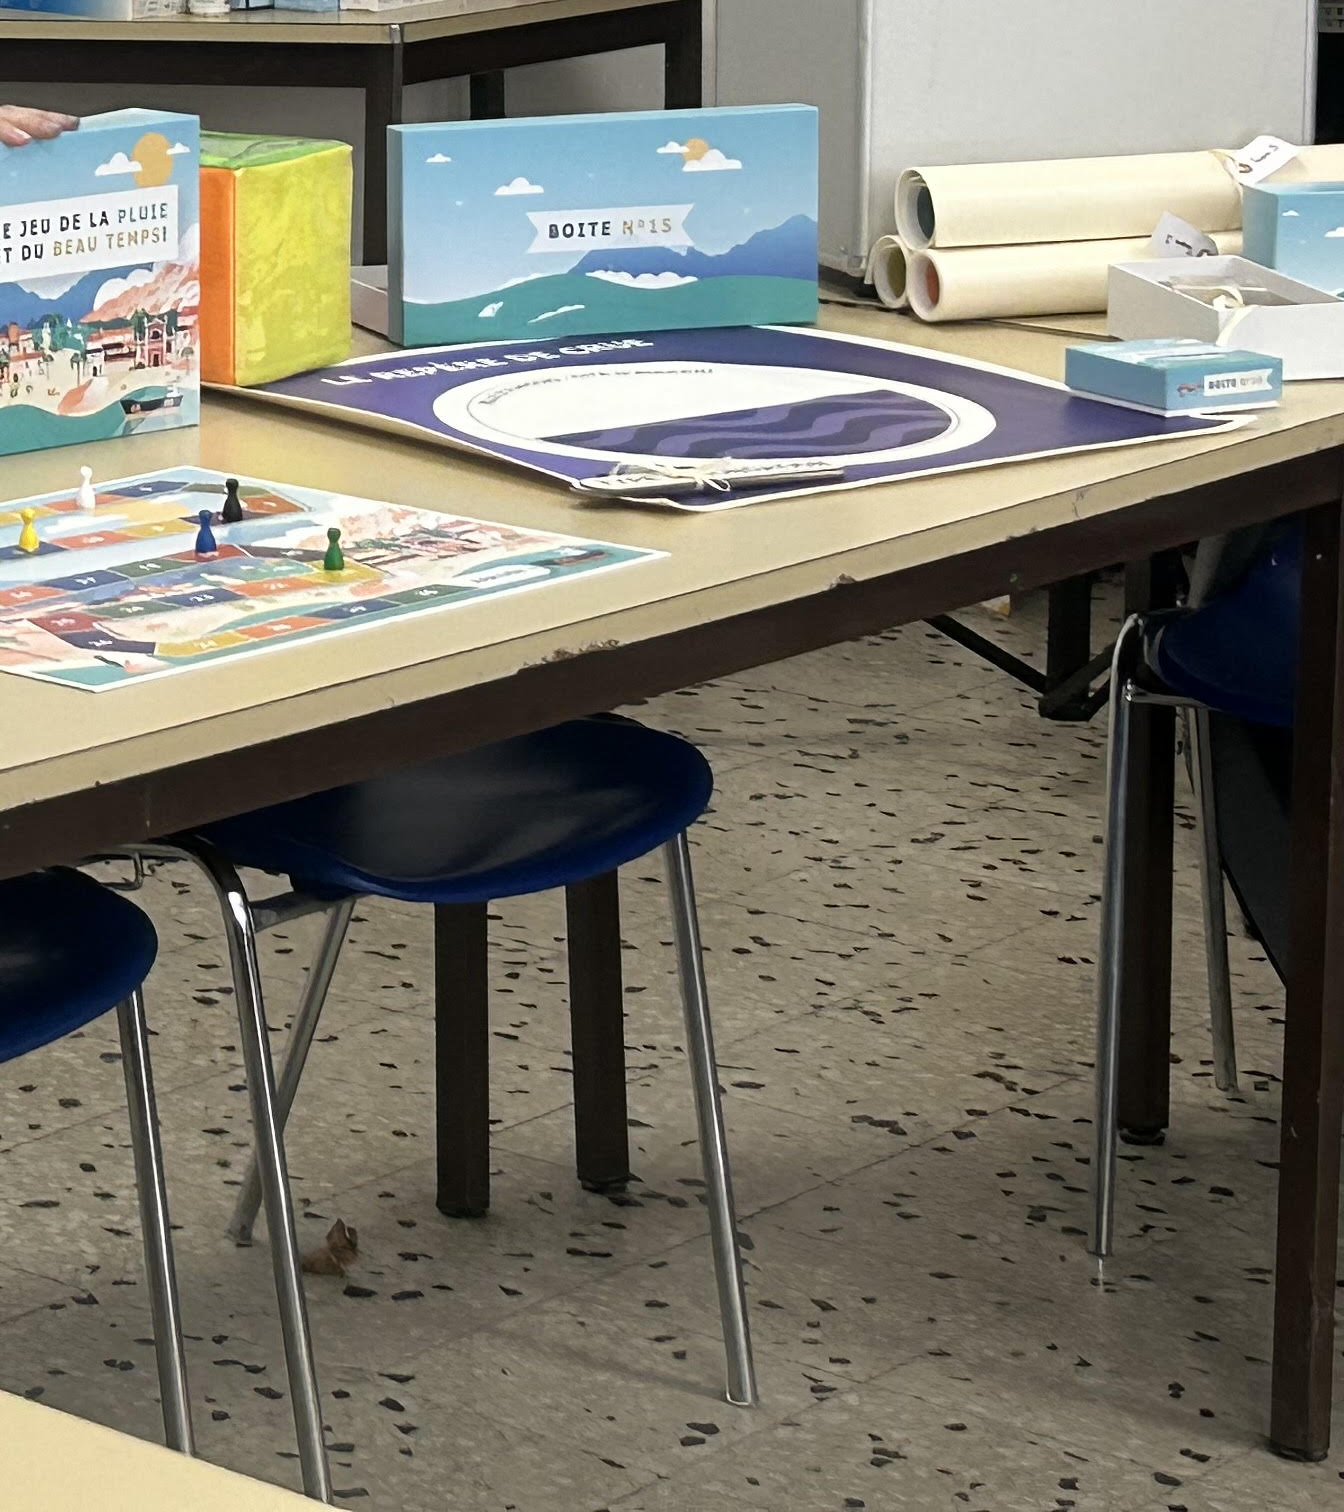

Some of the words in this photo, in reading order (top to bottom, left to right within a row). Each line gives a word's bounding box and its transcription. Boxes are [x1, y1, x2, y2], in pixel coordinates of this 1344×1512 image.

[19, 217, 51, 238] JEU
[59, 212, 82, 233] DE
[89, 209, 109, 229] LA
[117, 202, 169, 225] PLUIE
[548, 220, 611, 240] BOITE
[21, 242, 44, 262] DU
[52, 234, 98, 258] BEAU
